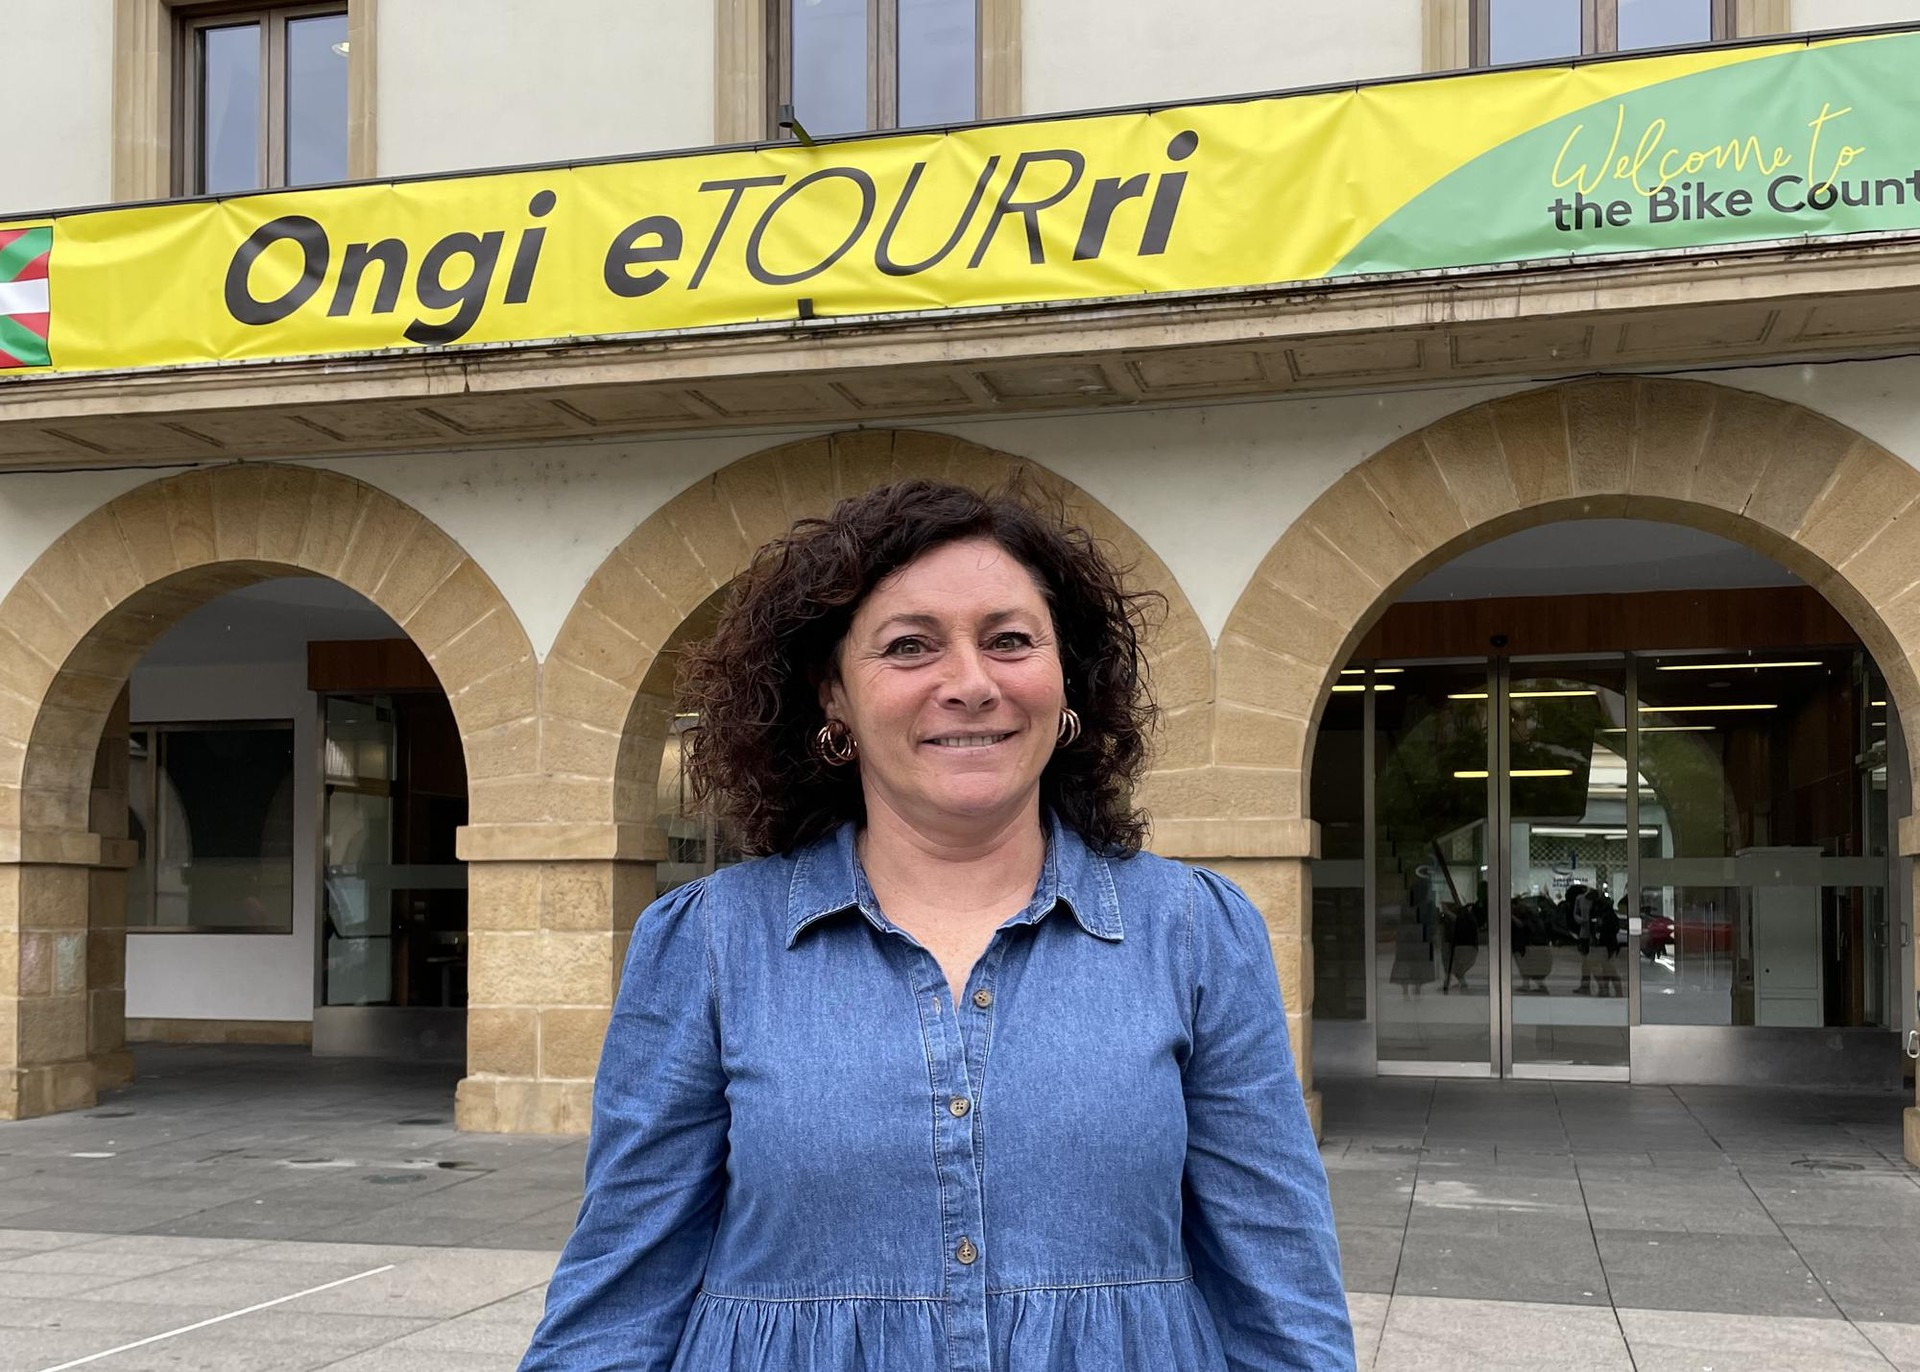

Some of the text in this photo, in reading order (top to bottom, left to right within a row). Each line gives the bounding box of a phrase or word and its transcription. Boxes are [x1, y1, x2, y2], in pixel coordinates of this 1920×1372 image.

[1551, 102, 1866, 196] Welcome to
[225, 130, 1198, 344] Ongi eTOURri
[1547, 191, 1632, 231] the
[1648, 181, 1753, 223] Bike
